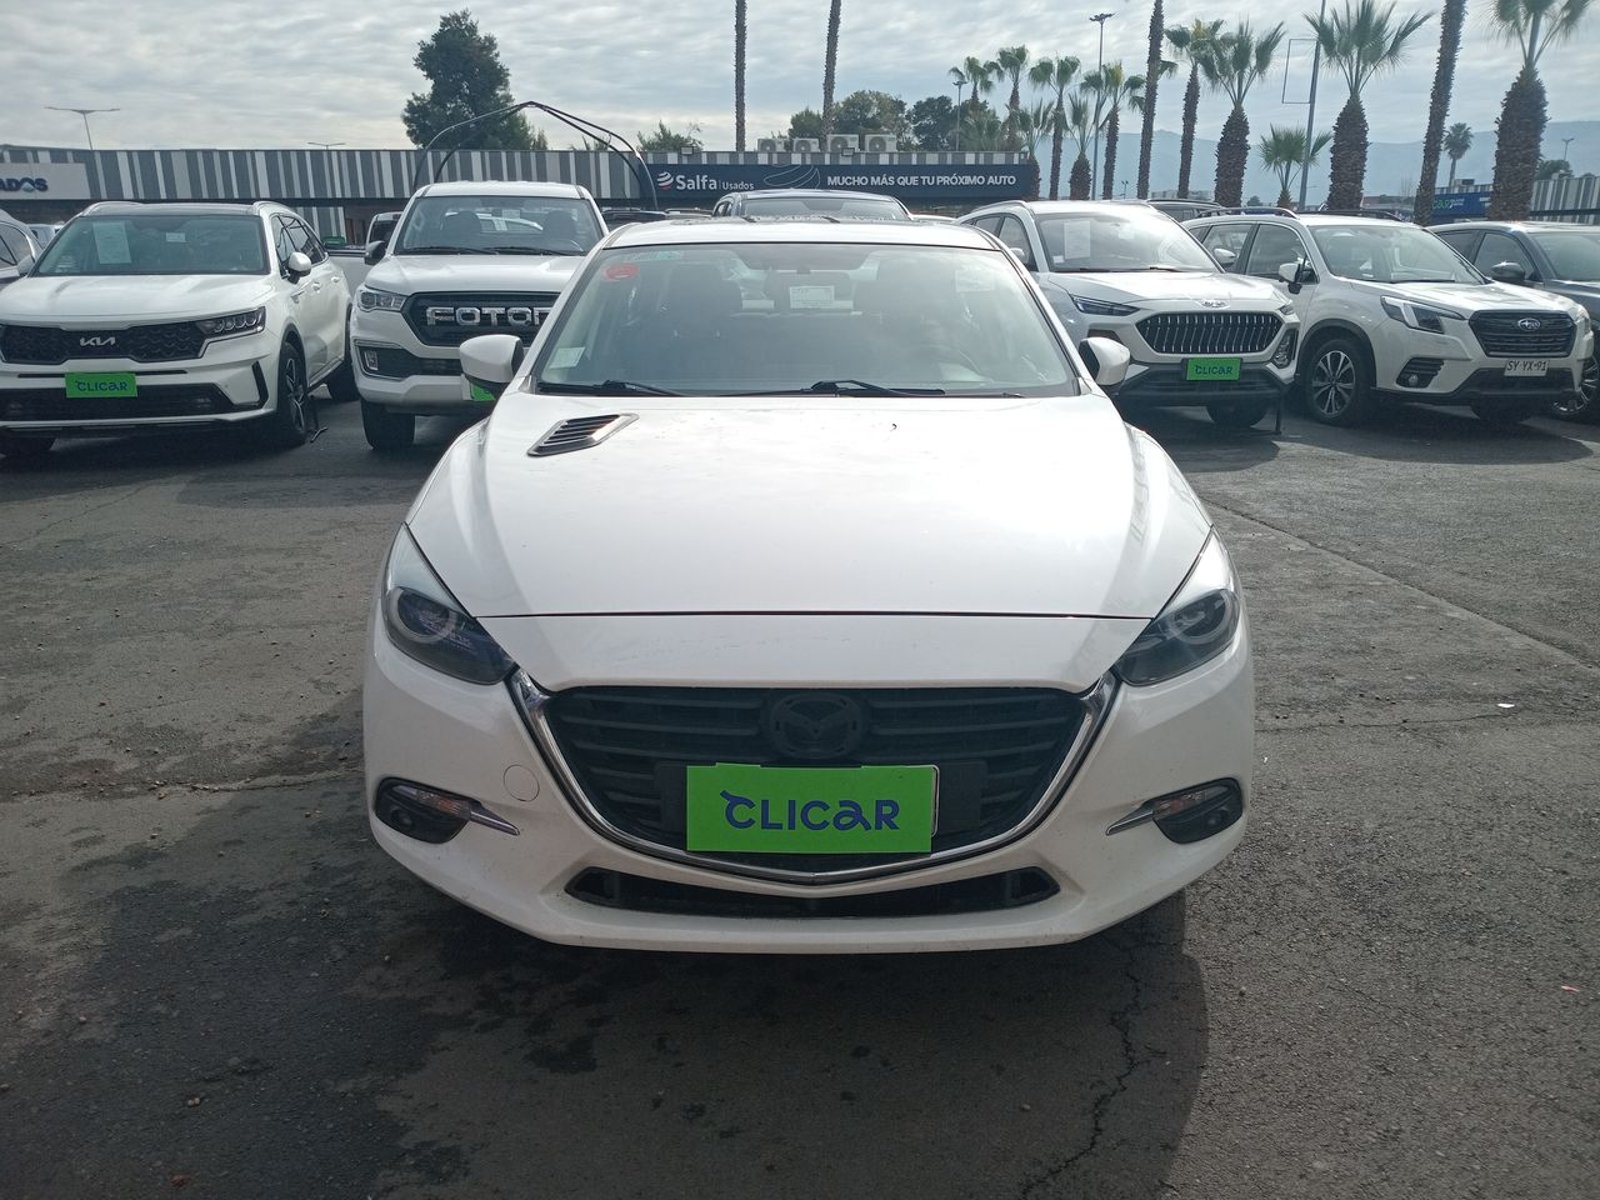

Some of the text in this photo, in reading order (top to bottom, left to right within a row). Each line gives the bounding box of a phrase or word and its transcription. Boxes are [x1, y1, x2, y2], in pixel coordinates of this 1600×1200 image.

[675, 174, 755, 192] Salfa Usados
[827, 173, 1017, 187] MUCHO MÁS QUE TU PRÓXIMO AUTO
